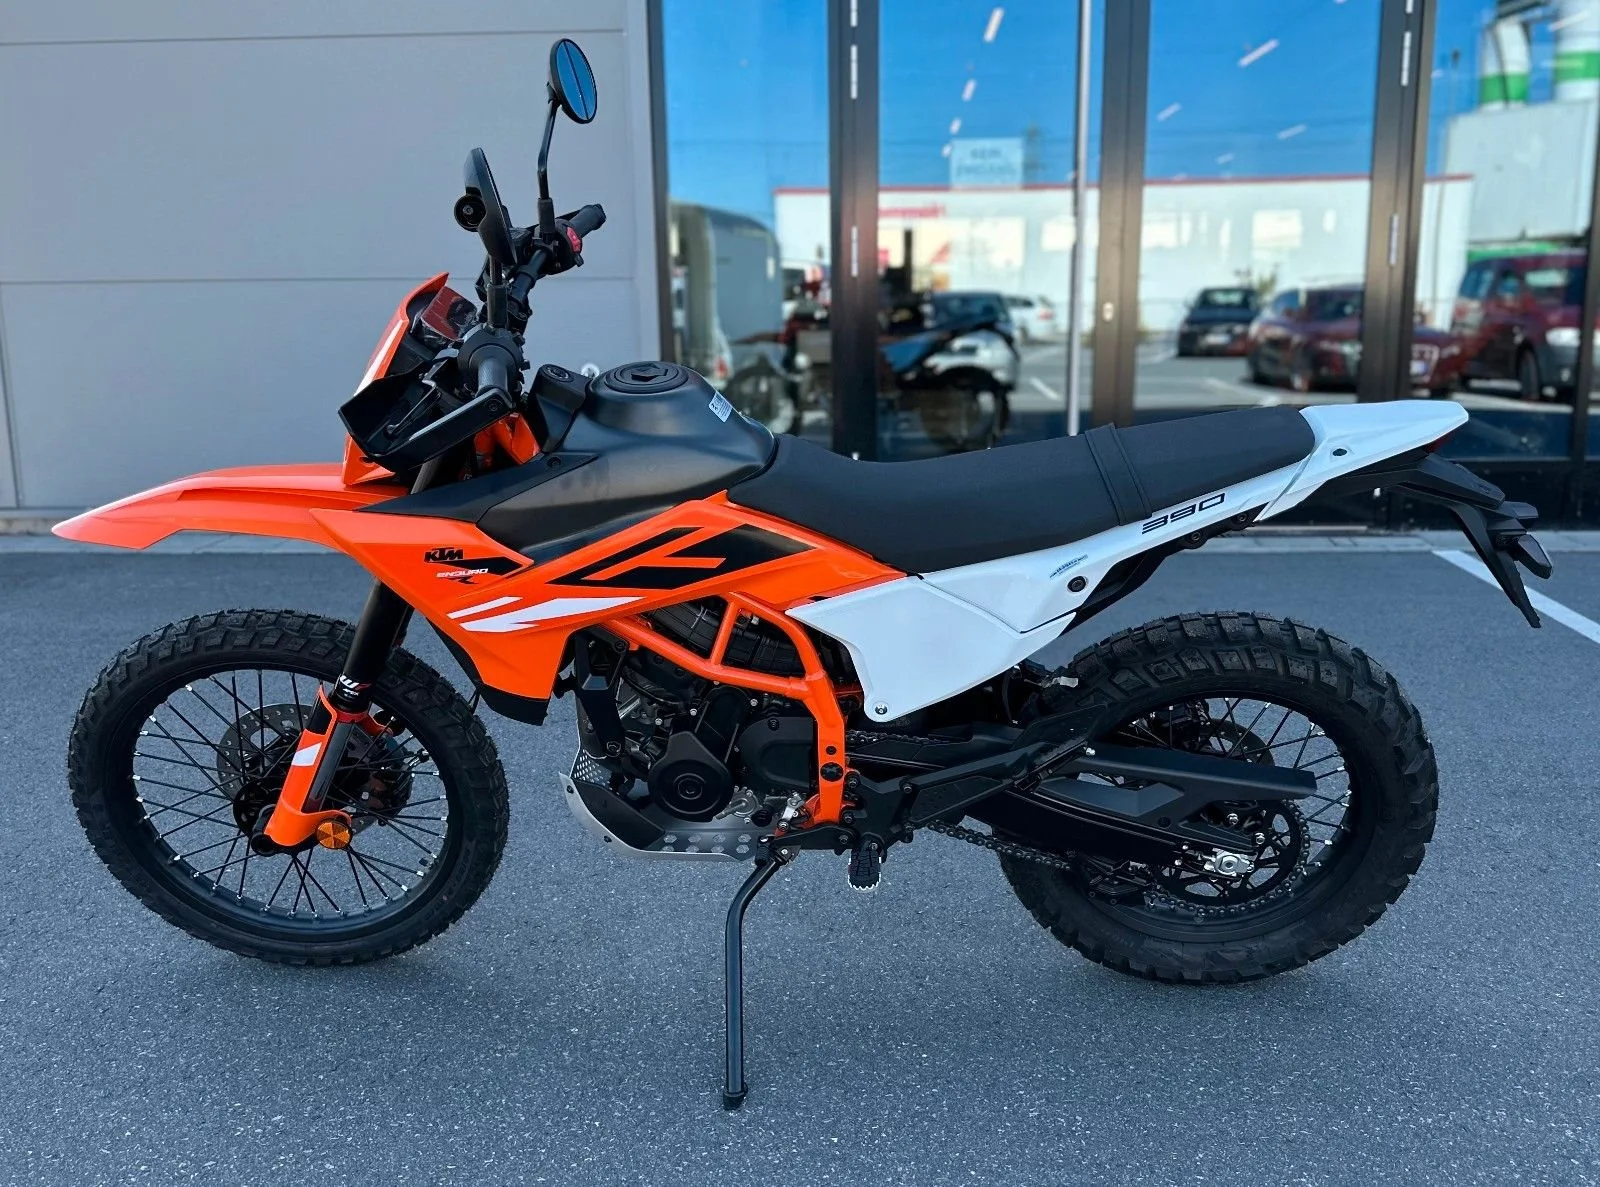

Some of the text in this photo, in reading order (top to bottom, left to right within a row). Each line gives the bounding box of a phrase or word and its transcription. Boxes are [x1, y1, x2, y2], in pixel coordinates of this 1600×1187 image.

[1141, 493, 1225, 535] 390
[424, 547, 464, 563] KTM
[436, 568, 489, 578] ENDURO
